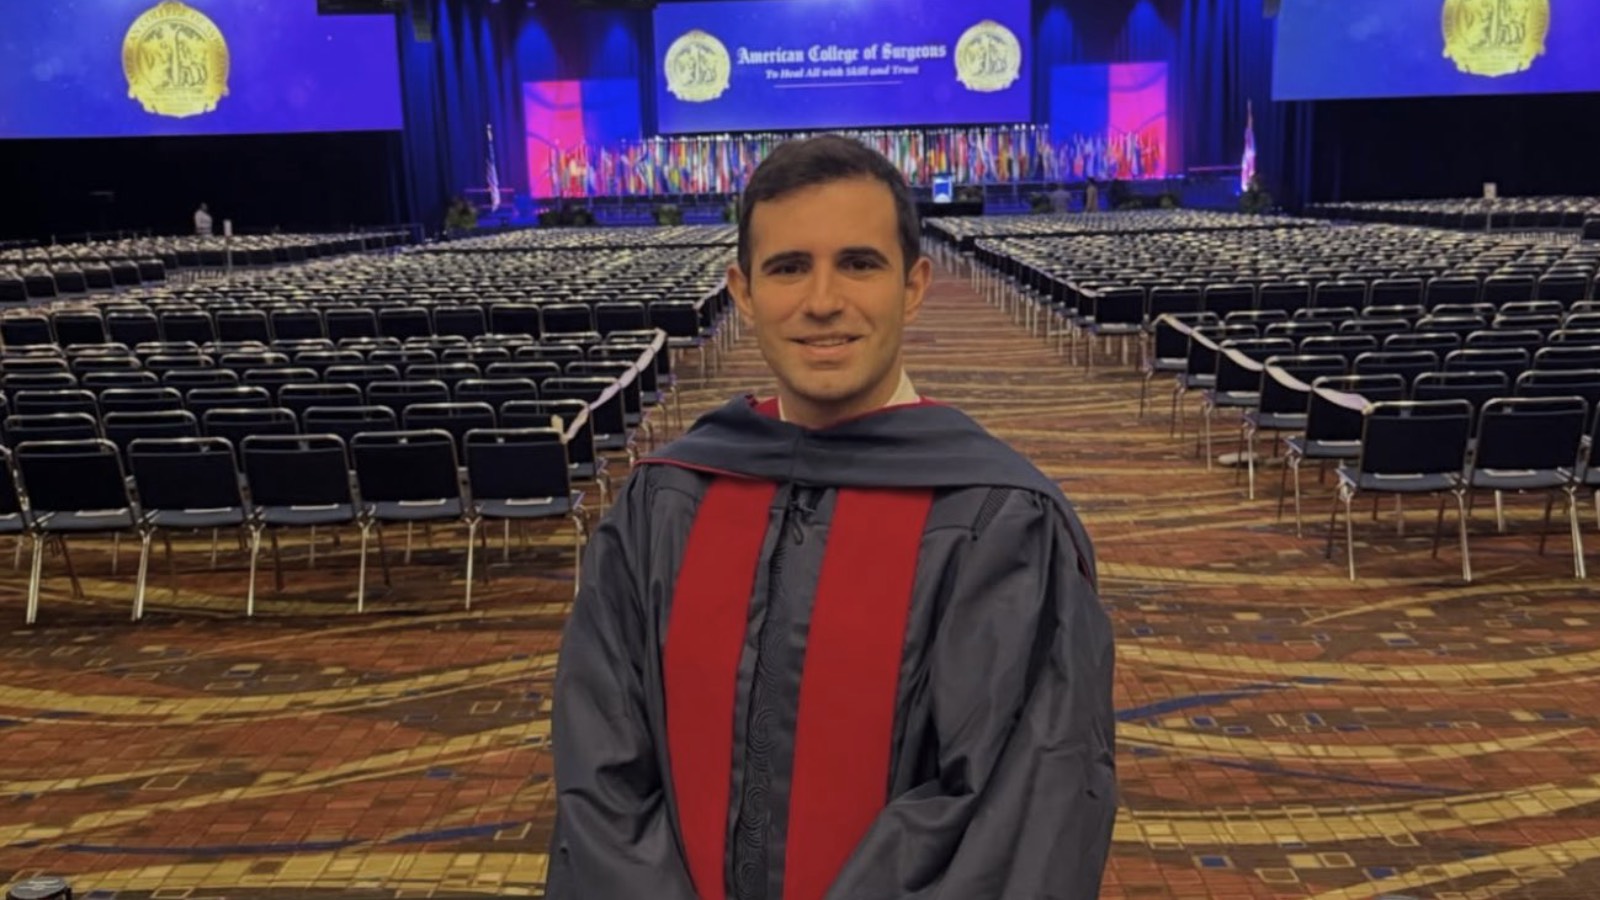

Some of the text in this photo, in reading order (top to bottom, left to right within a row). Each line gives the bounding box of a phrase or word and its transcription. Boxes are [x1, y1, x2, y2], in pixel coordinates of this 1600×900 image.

[737, 42, 947, 65] American College of Surgeons
[765, 64, 919, 79] To Heal All with Skill and Trust
